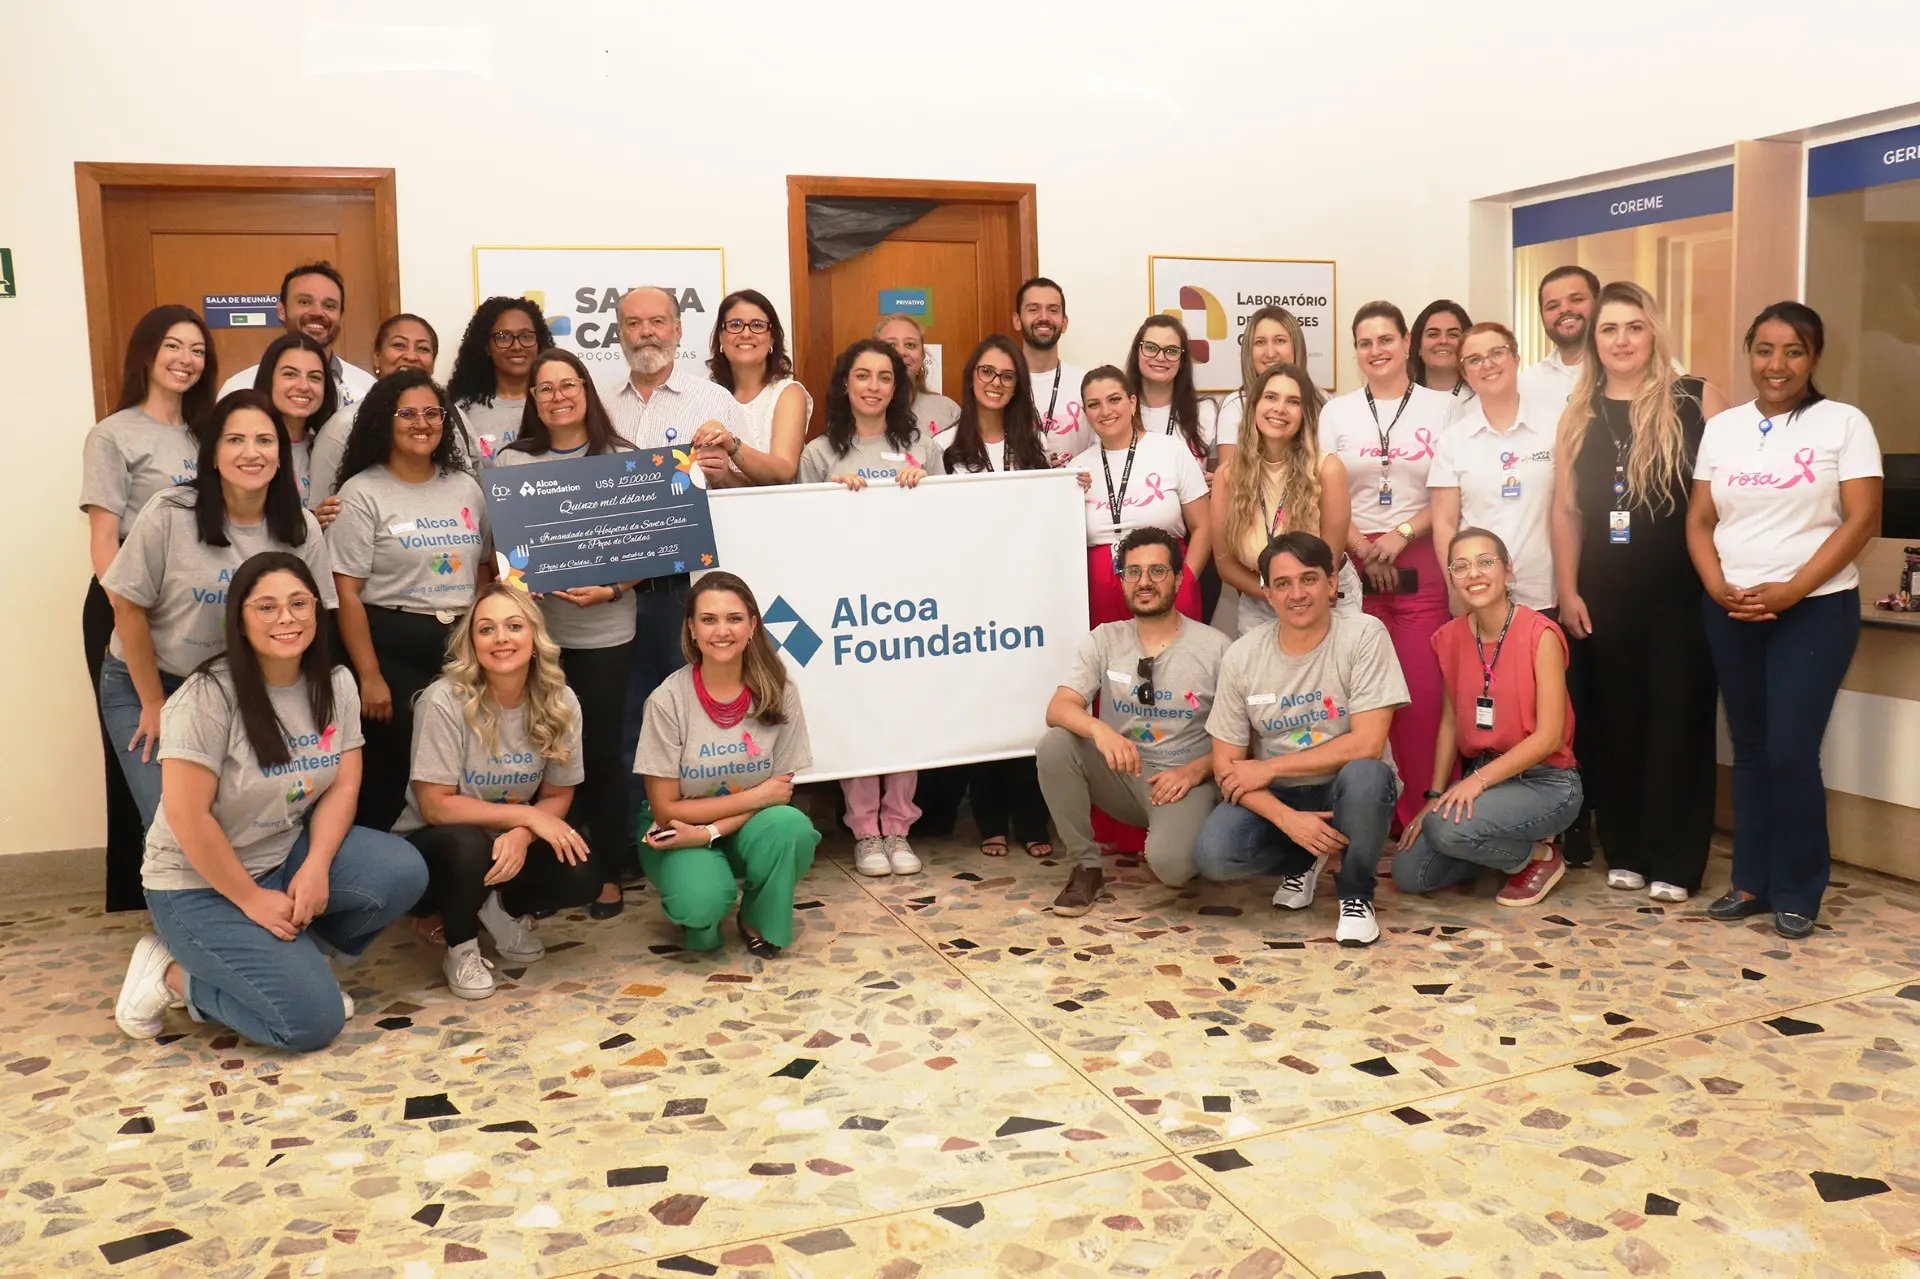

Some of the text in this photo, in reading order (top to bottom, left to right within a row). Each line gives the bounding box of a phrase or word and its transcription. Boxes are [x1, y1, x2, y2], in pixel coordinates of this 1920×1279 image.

[1883, 145, 1920, 165] GER
[1610, 195, 1664, 215] COREME
[206, 295, 278, 304] SALA DE REUNIÃO
[575, 287, 705, 313] SAA
[1237, 292, 1327, 306] LABORATÓRIO
[578, 351, 620, 362] POÇOS
[857, 467, 897, 479] Alcoa
[1728, 473, 1781, 487] rosa
[536, 480, 558, 488] Alcoa
[537, 484, 581, 496] Foundation
[595, 478, 615, 489] US$
[559, 492, 657, 515] Quinze mil dólares
[1096, 497, 1139, 510] roa
[416, 518, 458, 529] Alcoa
[585, 529, 593, 537] de
[594, 524, 629, 536] Hospital
[630, 523, 640, 531] da
[641, 519, 666, 529] Santa
[666, 516, 687, 526] Casa
[399, 533, 482, 550] Volunteers
[587, 538, 612, 550] Poços
[622, 533, 651, 544] Caldas
[656, 544, 679, 554] 2025
[831, 594, 938, 629] Alcoa
[833, 620, 1044, 666] Foundation
[1131, 685, 1173, 700] Aoa
[1280, 690, 1322, 709] Alcoa
[1112, 698, 1194, 720] Volunteers
[1261, 705, 1346, 732] Voluntes
[288, 733, 319, 749] coa
[699, 741, 748, 758] Alcoa
[487, 751, 533, 765] Acoa
[463, 768, 544, 786] Voluntee
[681, 758, 771, 780] Volunteers
